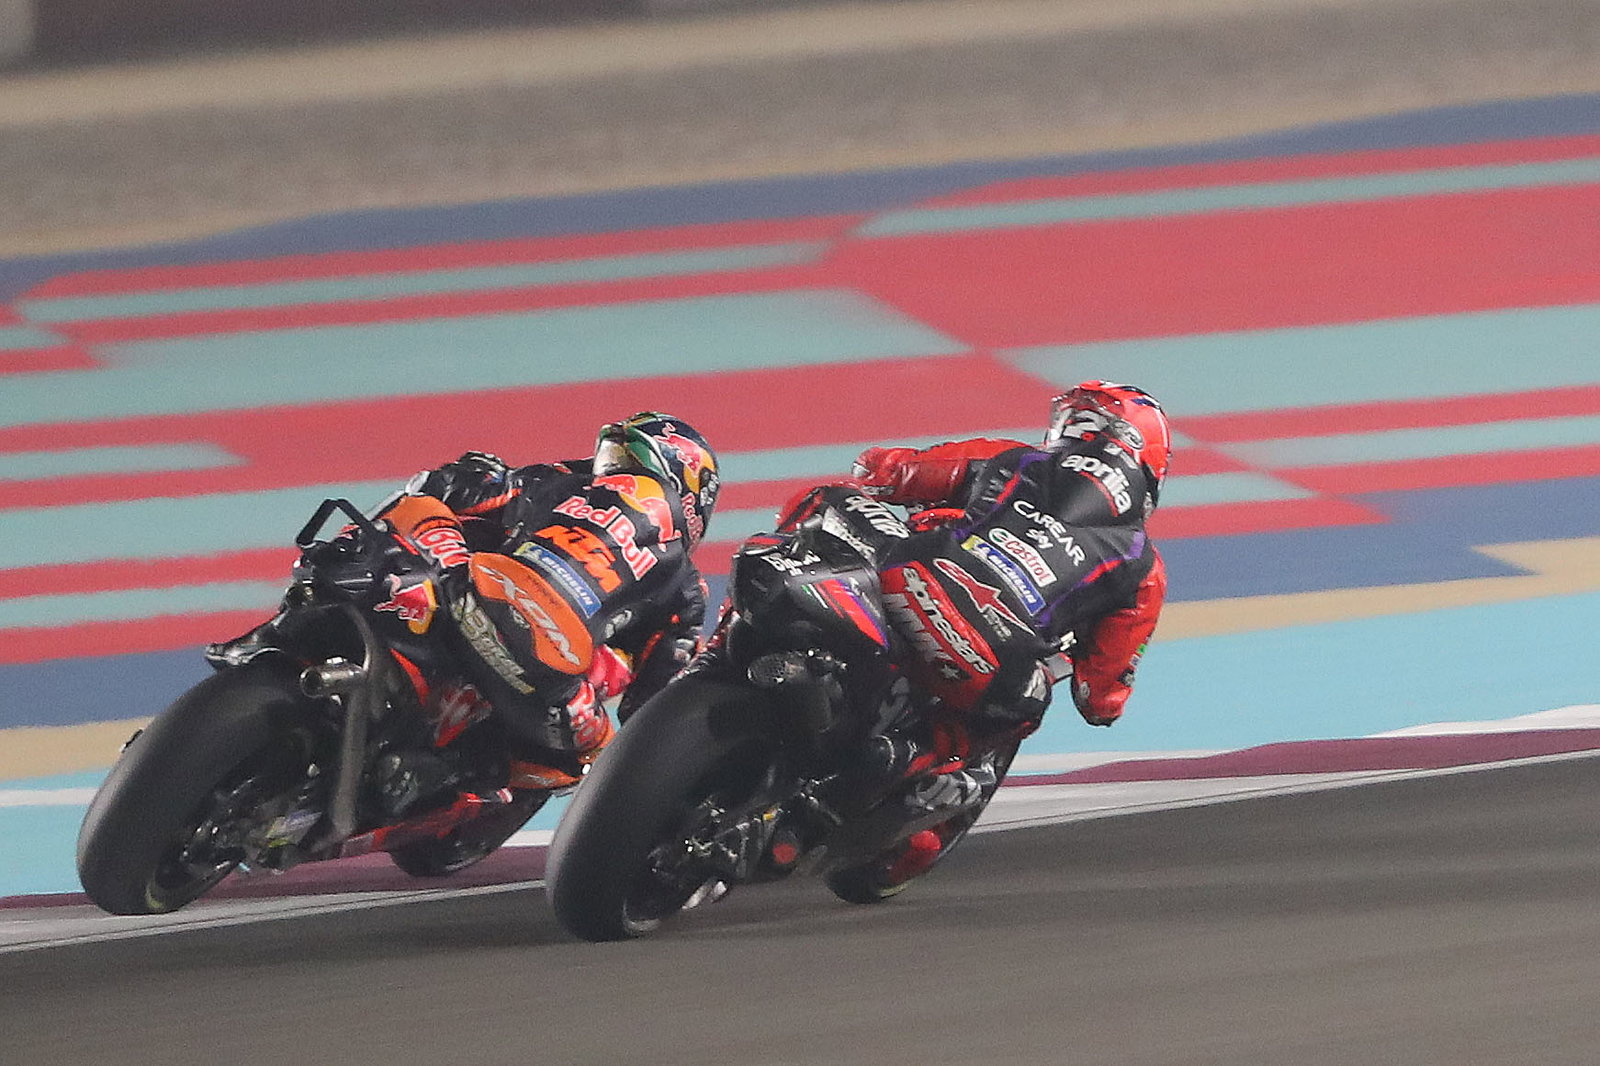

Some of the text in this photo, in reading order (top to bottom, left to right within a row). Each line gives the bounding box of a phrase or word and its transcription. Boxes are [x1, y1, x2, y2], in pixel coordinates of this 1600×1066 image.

[1060, 454, 1133, 514] aprilia
[533, 524, 624, 594] KTM
[552, 495, 622, 529] Red
[606, 514, 659, 582] Bull
[540, 556, 594, 606] MICHELIN
[987, 553, 1038, 604] MICHELIN
[903, 567, 996, 674] alpinestars
